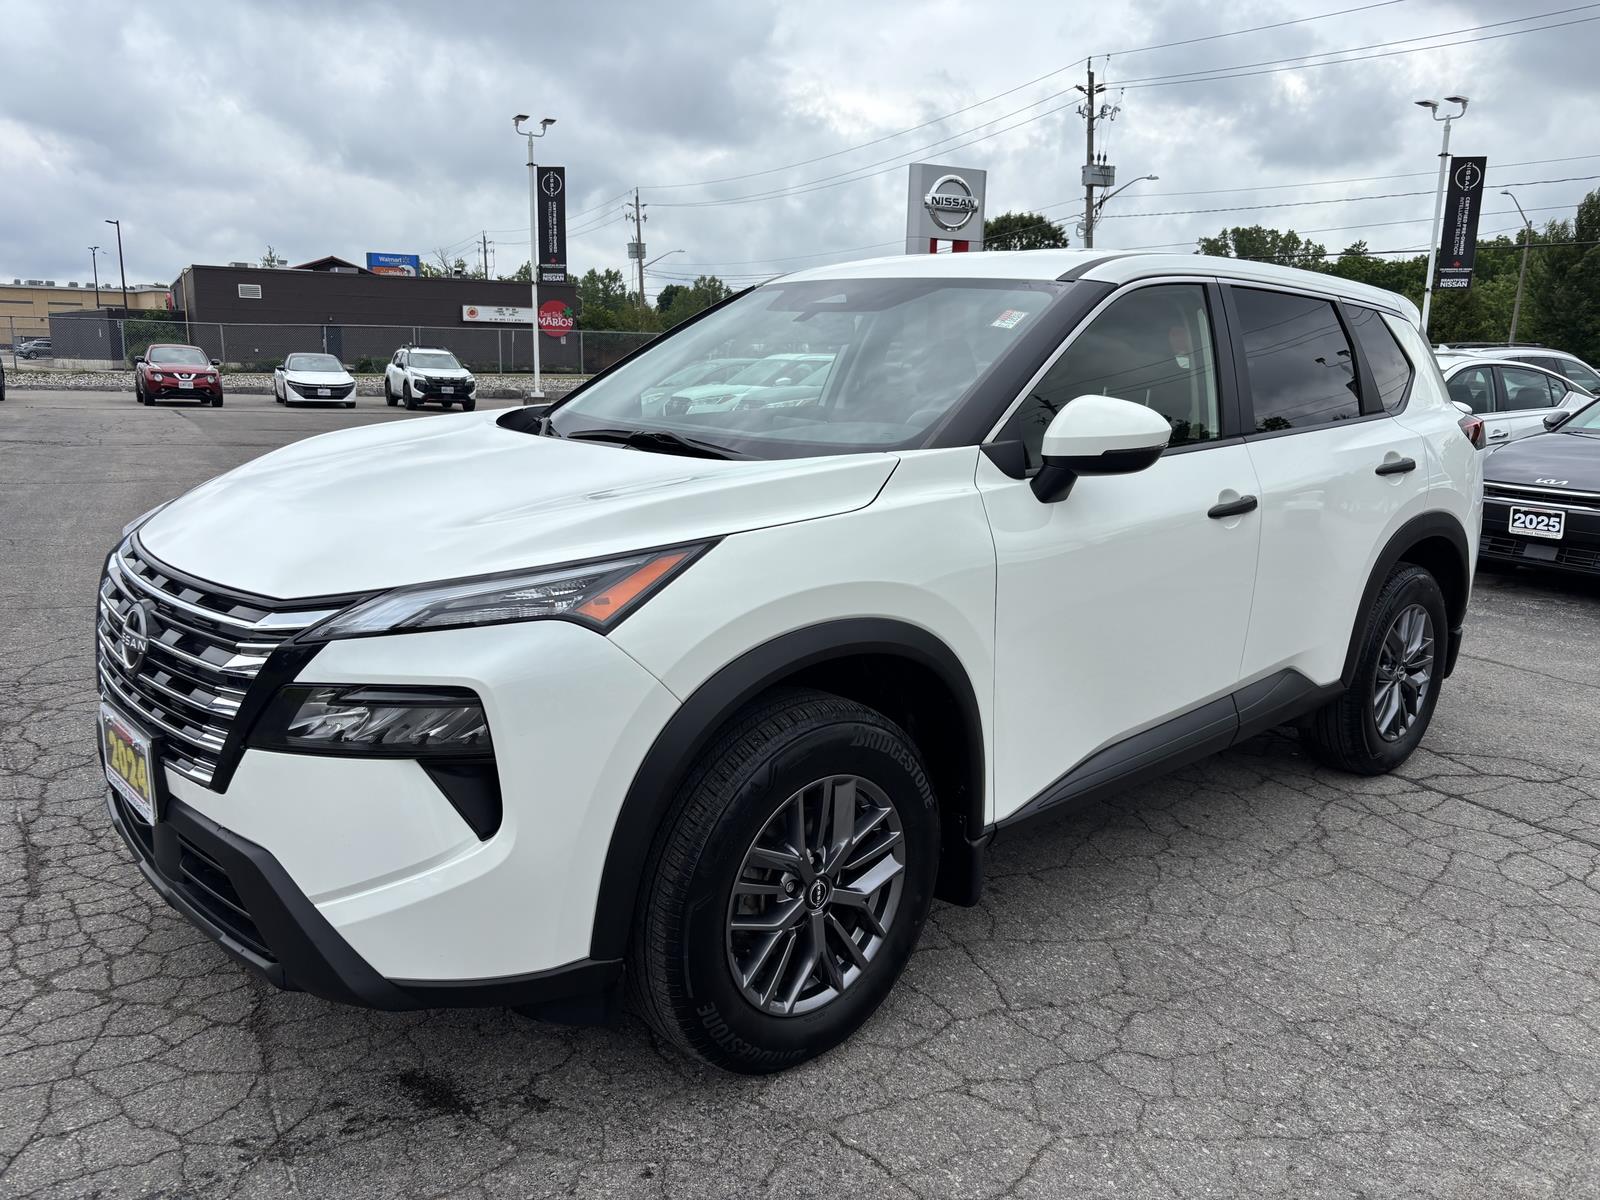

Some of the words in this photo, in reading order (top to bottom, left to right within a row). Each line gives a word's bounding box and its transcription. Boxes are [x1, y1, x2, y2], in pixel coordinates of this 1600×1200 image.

[1463, 162, 1472, 191] NISSAN
[931, 196, 974, 209] NISSAN
[1459, 224, 1467, 255] PRE-OWNED
[1513, 513, 1560, 532] 2025
[108, 730, 150, 800] 2024
[850, 726, 935, 808] BRIDGESTONE
